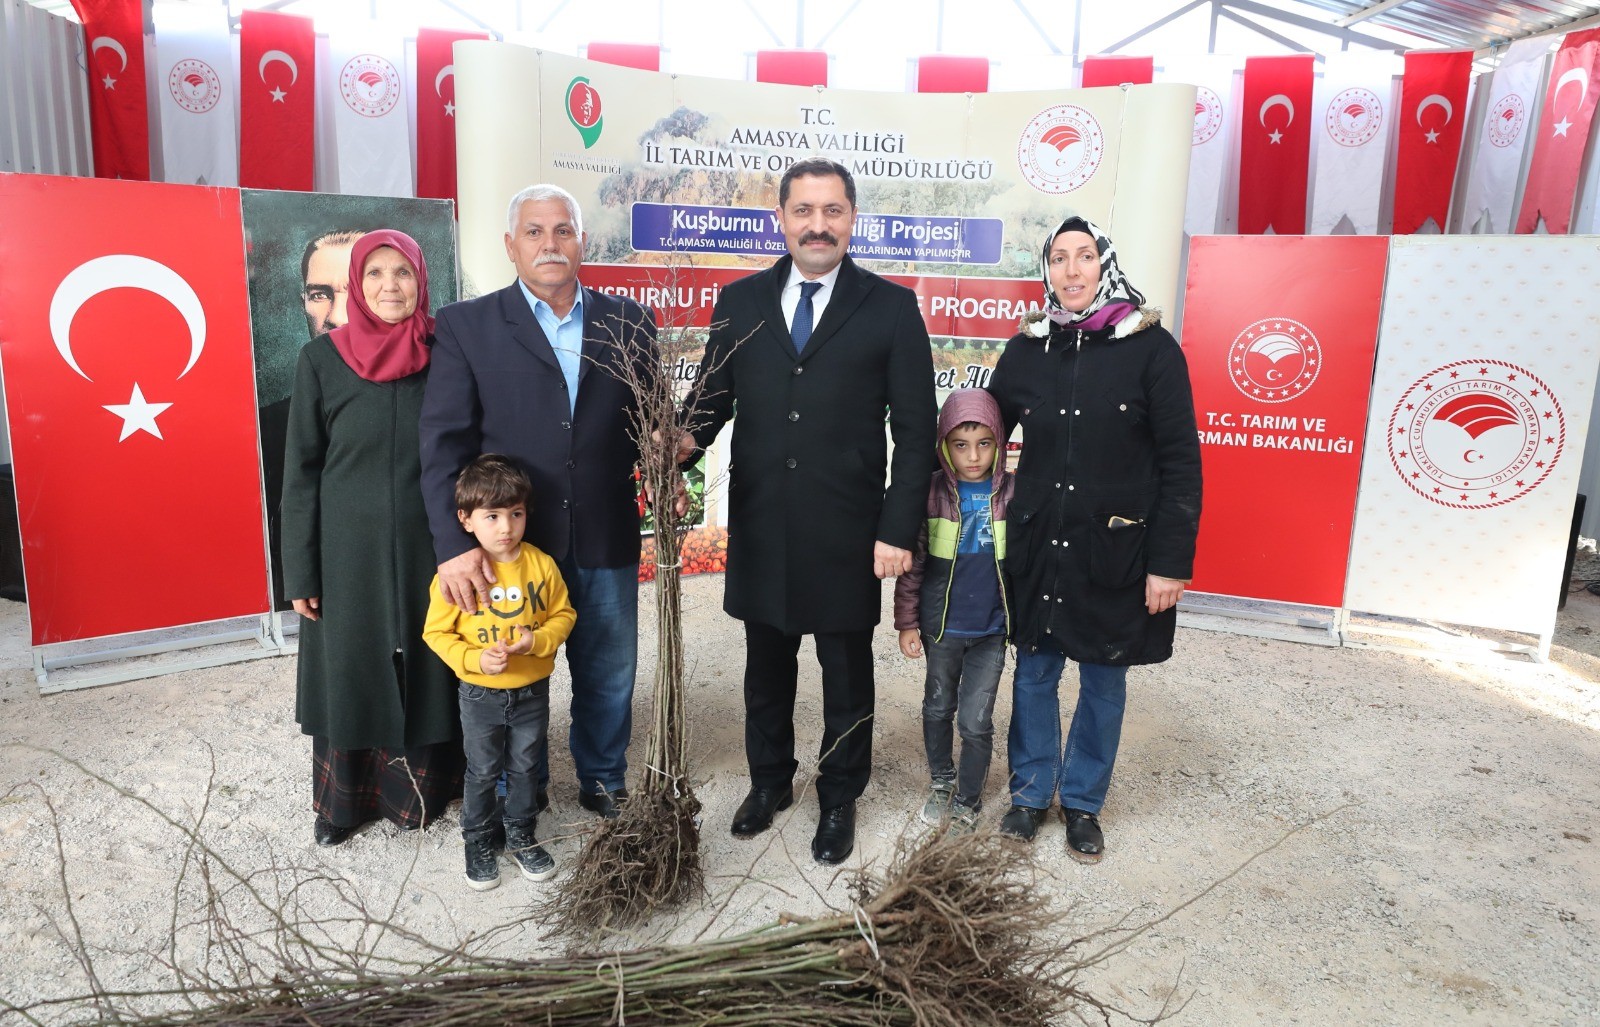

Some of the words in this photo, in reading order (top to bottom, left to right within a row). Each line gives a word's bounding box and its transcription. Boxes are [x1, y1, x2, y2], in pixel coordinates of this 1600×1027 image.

[800, 107, 835, 126] T.C.
[729, 128, 810, 149] AMASYA
[814, 132, 905, 153] VALİLİĞİ
[553, 160, 584, 171] AMASYA
[646, 142, 664, 164] İL
[670, 147, 733, 169] TARIM
[740, 154, 761, 170] VE
[852, 159, 994, 180] MÜDÜRLÜĞÜ
[673, 210, 764, 234] Kuşburnu
[891, 220, 959, 245] Projesi
[678, 237, 716, 248] AMASYA
[717, 237, 753, 249] VALİLİĞİ
[755, 238, 763, 250] İL
[764, 239, 787, 251] ÖZEL
[847, 245, 912, 256] NAKLARINDAN
[914, 247, 971, 259] YAPILMIŞTIR
[700, 283, 722, 308] Fİ
[1206, 412, 1235, 427] T.C.
[1240, 414, 1297, 430] TARIM
[1303, 417, 1327, 432] VE
[1413, 384, 1461, 440] CUMHURİYETİ
[1466, 382, 1502, 392] TARIM
[1506, 389, 1519, 401] VE
[1519, 401, 1537, 435] ORMAN
[1197, 430, 1247, 447] RMAN
[1252, 434, 1354, 454] BAKANLIĞI
[477, 624, 500, 643] at
